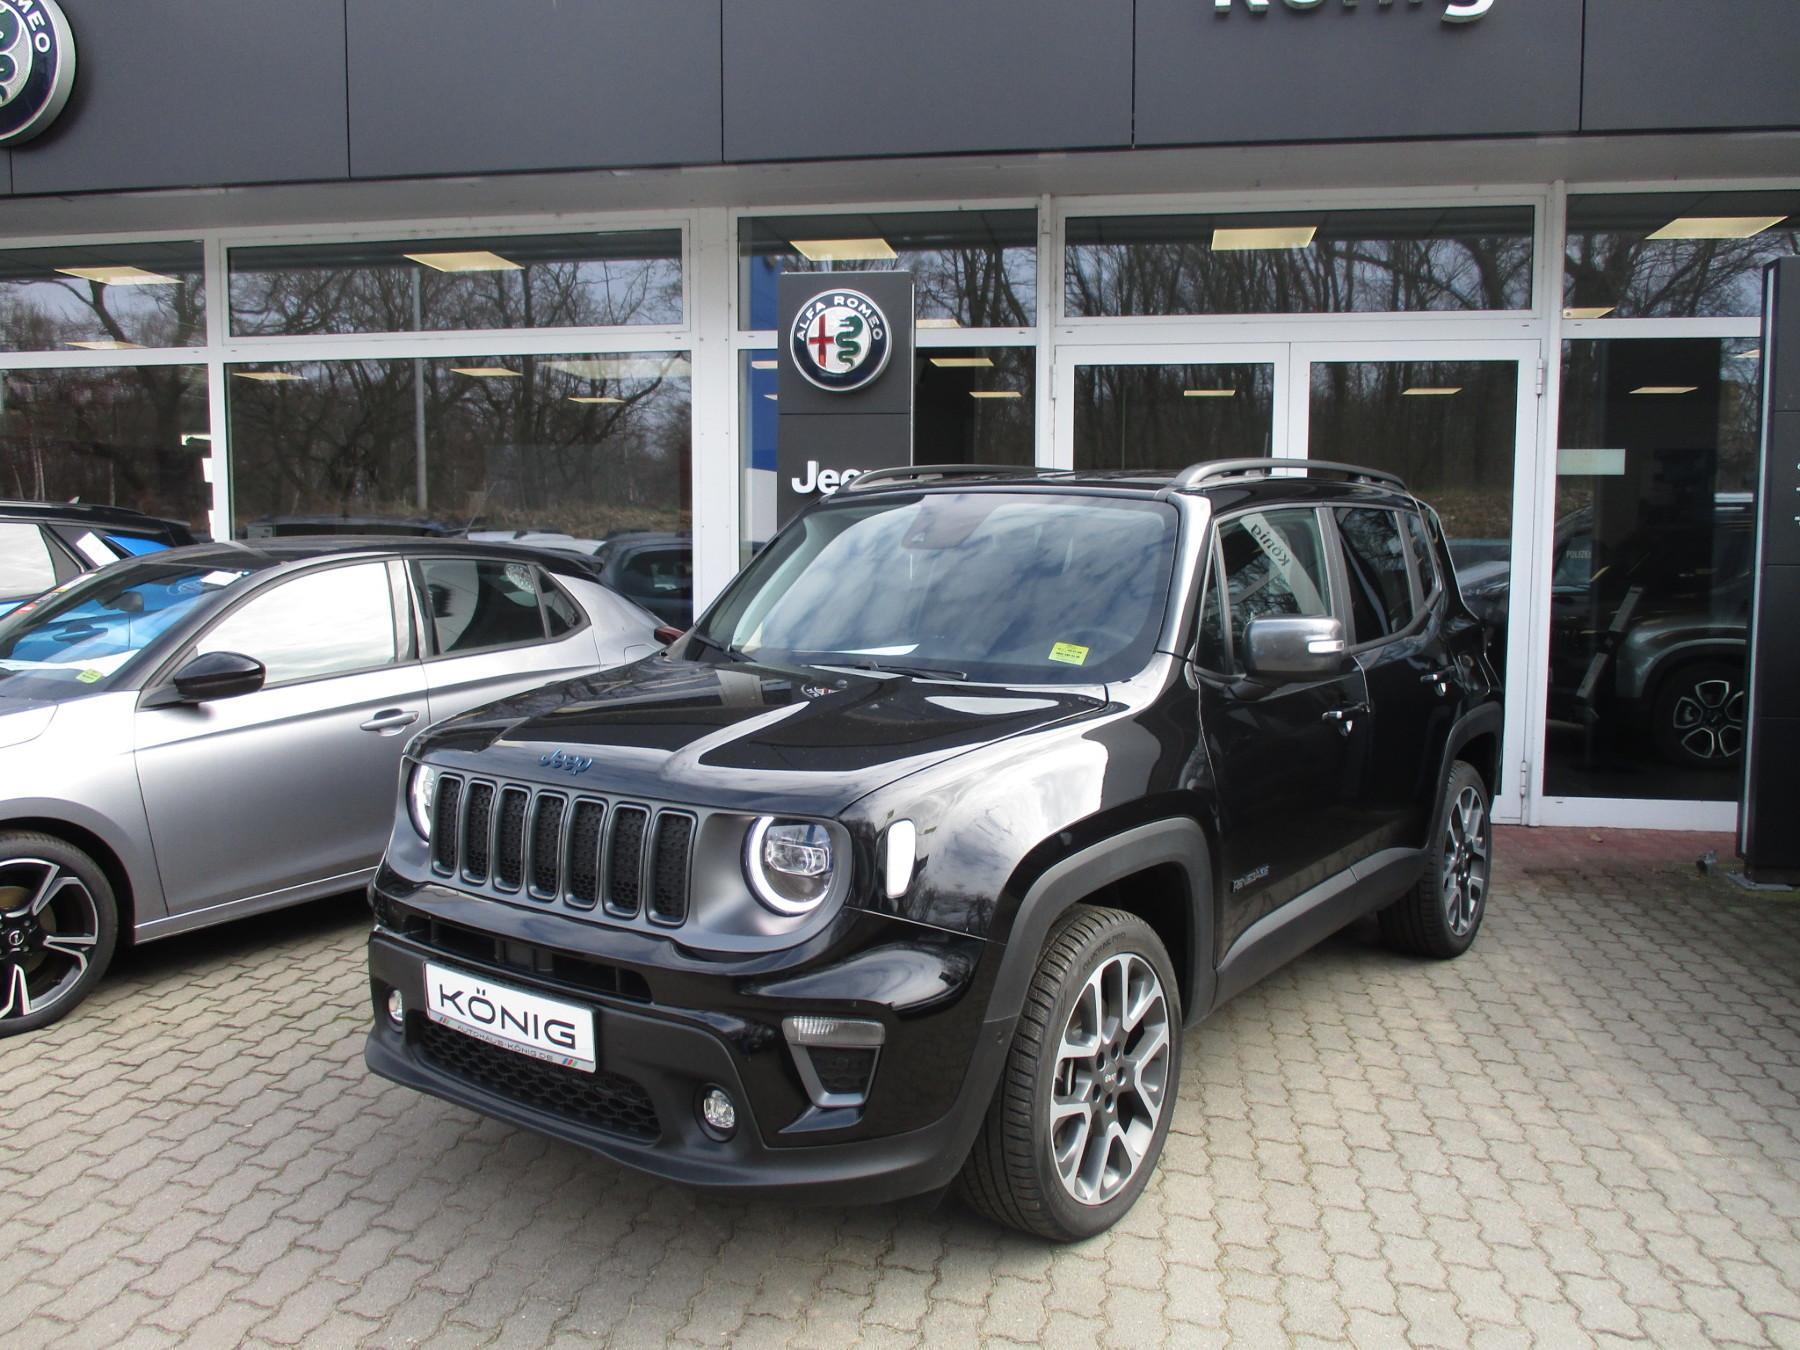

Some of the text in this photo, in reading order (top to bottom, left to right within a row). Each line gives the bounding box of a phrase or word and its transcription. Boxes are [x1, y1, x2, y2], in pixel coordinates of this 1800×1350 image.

[797, 296, 883, 341] ALFA ROMEO
[792, 460, 873, 494] Je
[539, 748, 593, 776] Jeep
[439, 984, 576, 1049] KÖNIG
